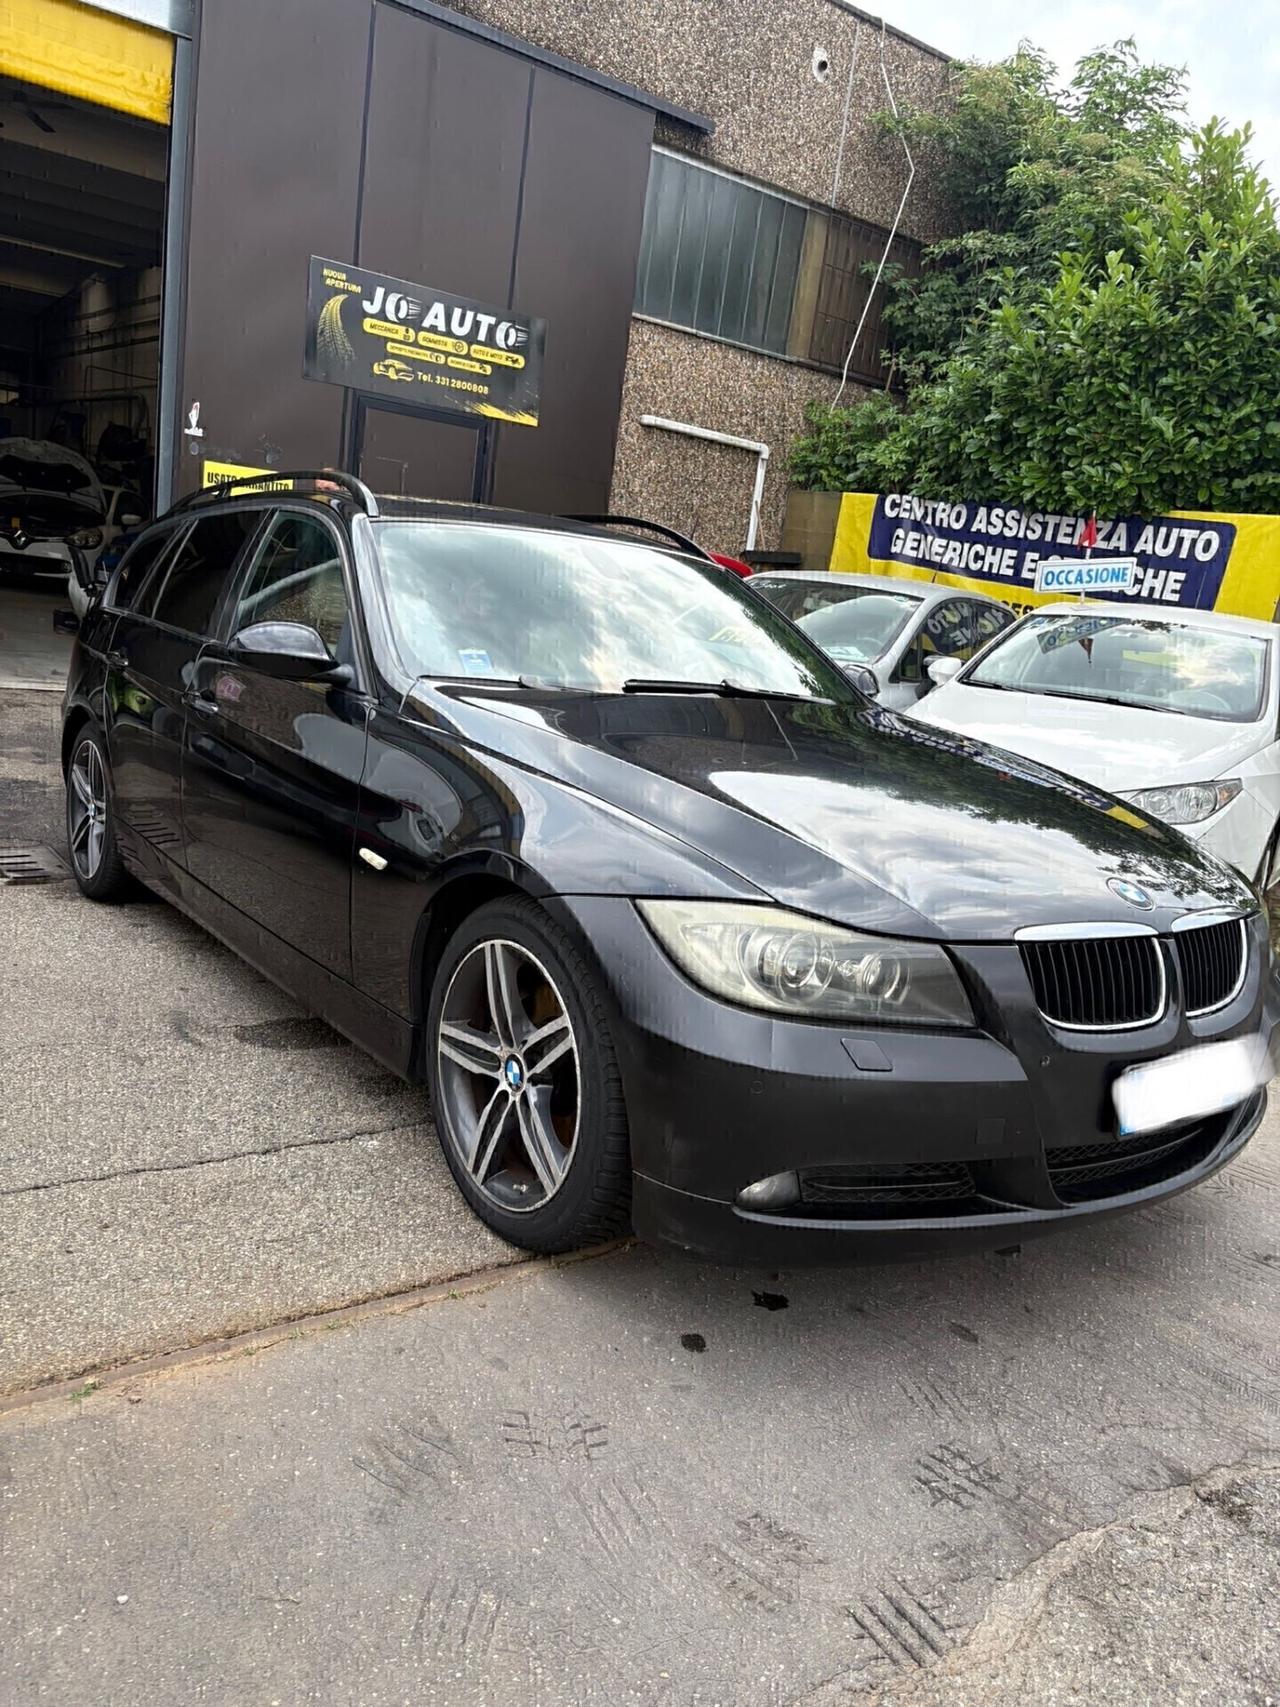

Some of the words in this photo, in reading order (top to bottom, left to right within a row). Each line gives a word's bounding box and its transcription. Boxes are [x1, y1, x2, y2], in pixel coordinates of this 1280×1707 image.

[362, 286, 408, 323] JO
[421, 302, 516, 349] AUTO
[417, 371, 433, 383] Tel.
[884, 494, 967, 530] CENTRO
[1133, 525, 1220, 562] AUTO
[890, 528, 1018, 576] GENERICHE
[1021, 552, 1040, 580] E
[1044, 567, 1130, 586] OCCASIONE
